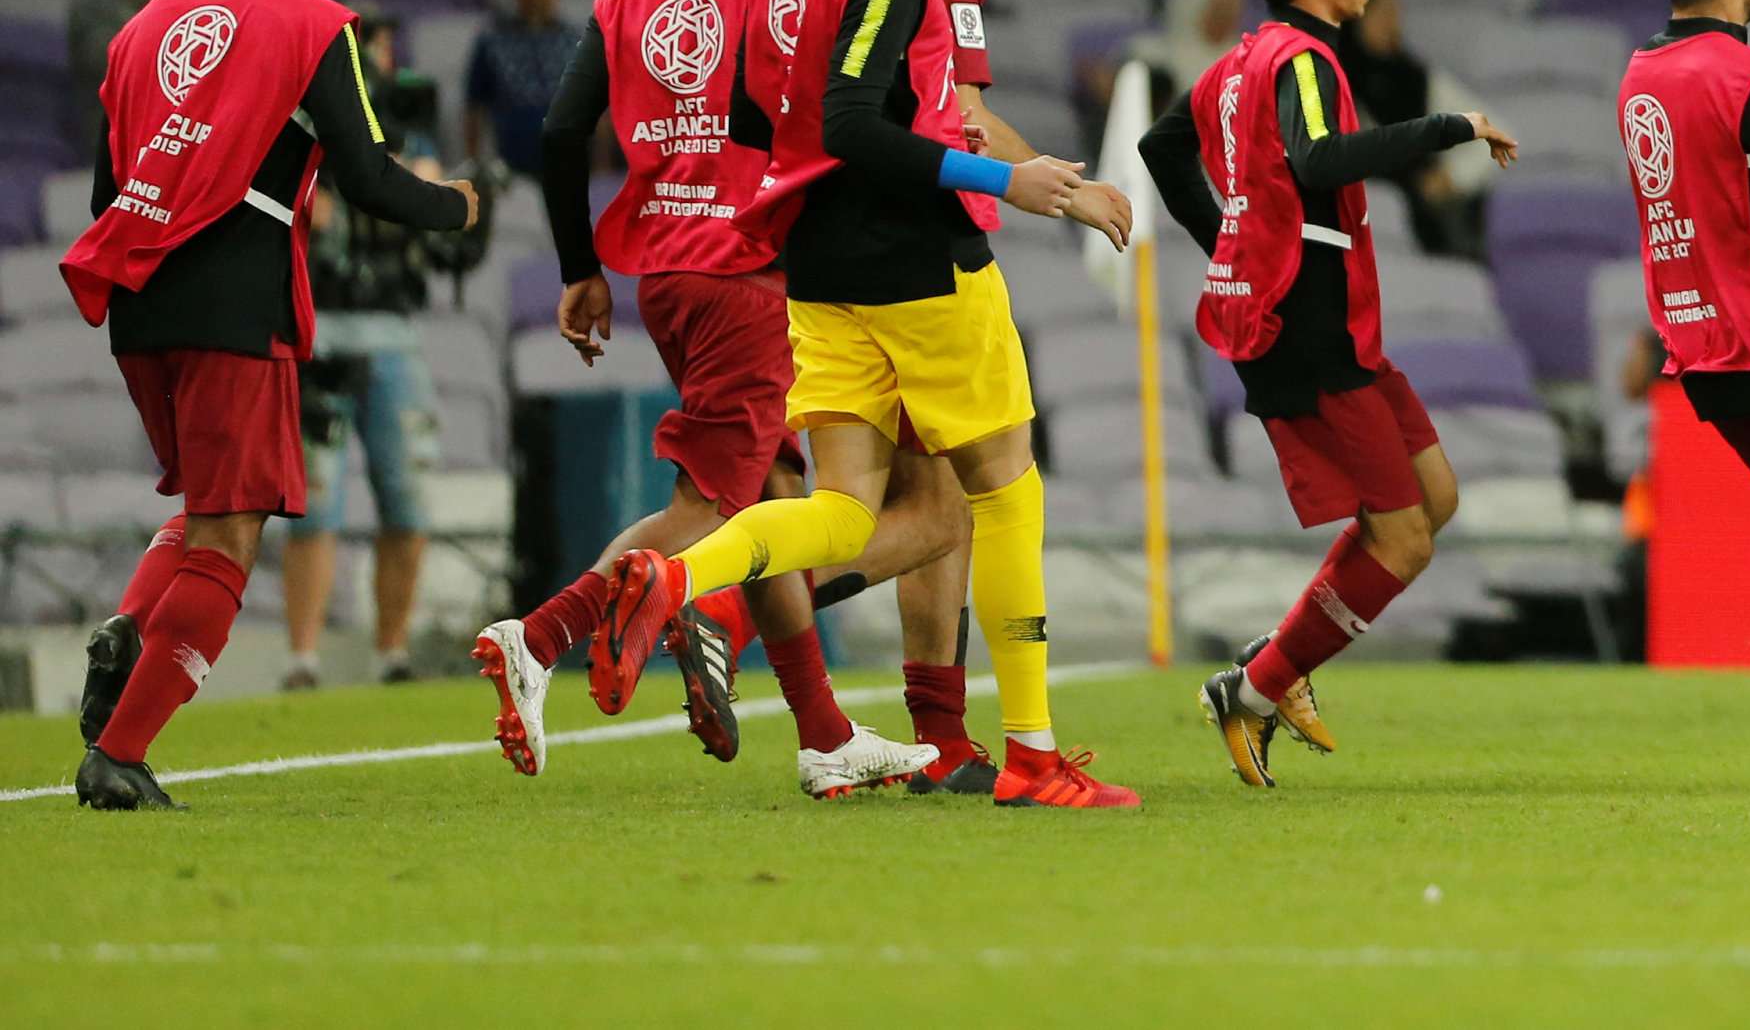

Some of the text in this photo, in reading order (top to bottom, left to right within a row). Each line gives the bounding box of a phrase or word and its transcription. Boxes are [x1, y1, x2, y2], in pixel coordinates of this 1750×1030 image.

[674, 96, 707, 115] AFC
[699, 114, 730, 137] CU
[149, 135, 185, 156] 019
[1647, 200, 1675, 223] AFC
